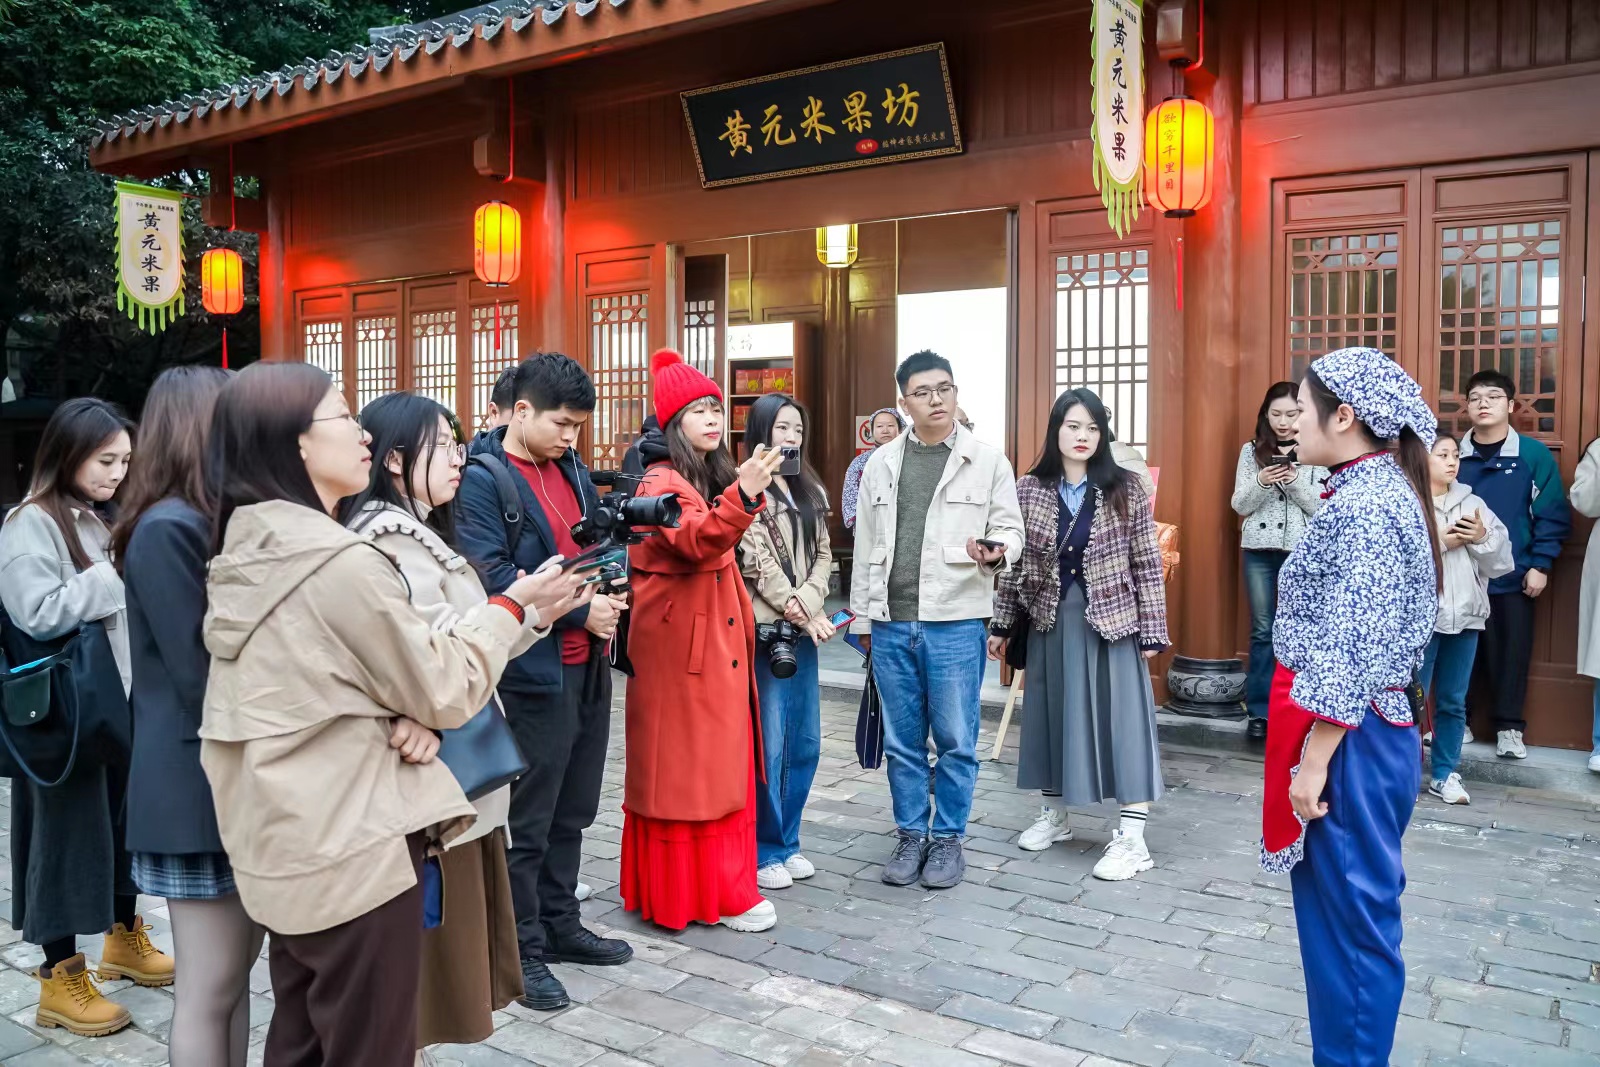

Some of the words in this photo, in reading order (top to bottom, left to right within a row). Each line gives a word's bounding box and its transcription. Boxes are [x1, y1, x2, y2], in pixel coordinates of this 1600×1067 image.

[718, 82, 920, 158] 黄元米果坊
[1109, 18, 1129, 162] 黄元米果
[1161, 112, 1177, 190] 欲穷千里目
[137, 211, 163, 292] 黄元米果
